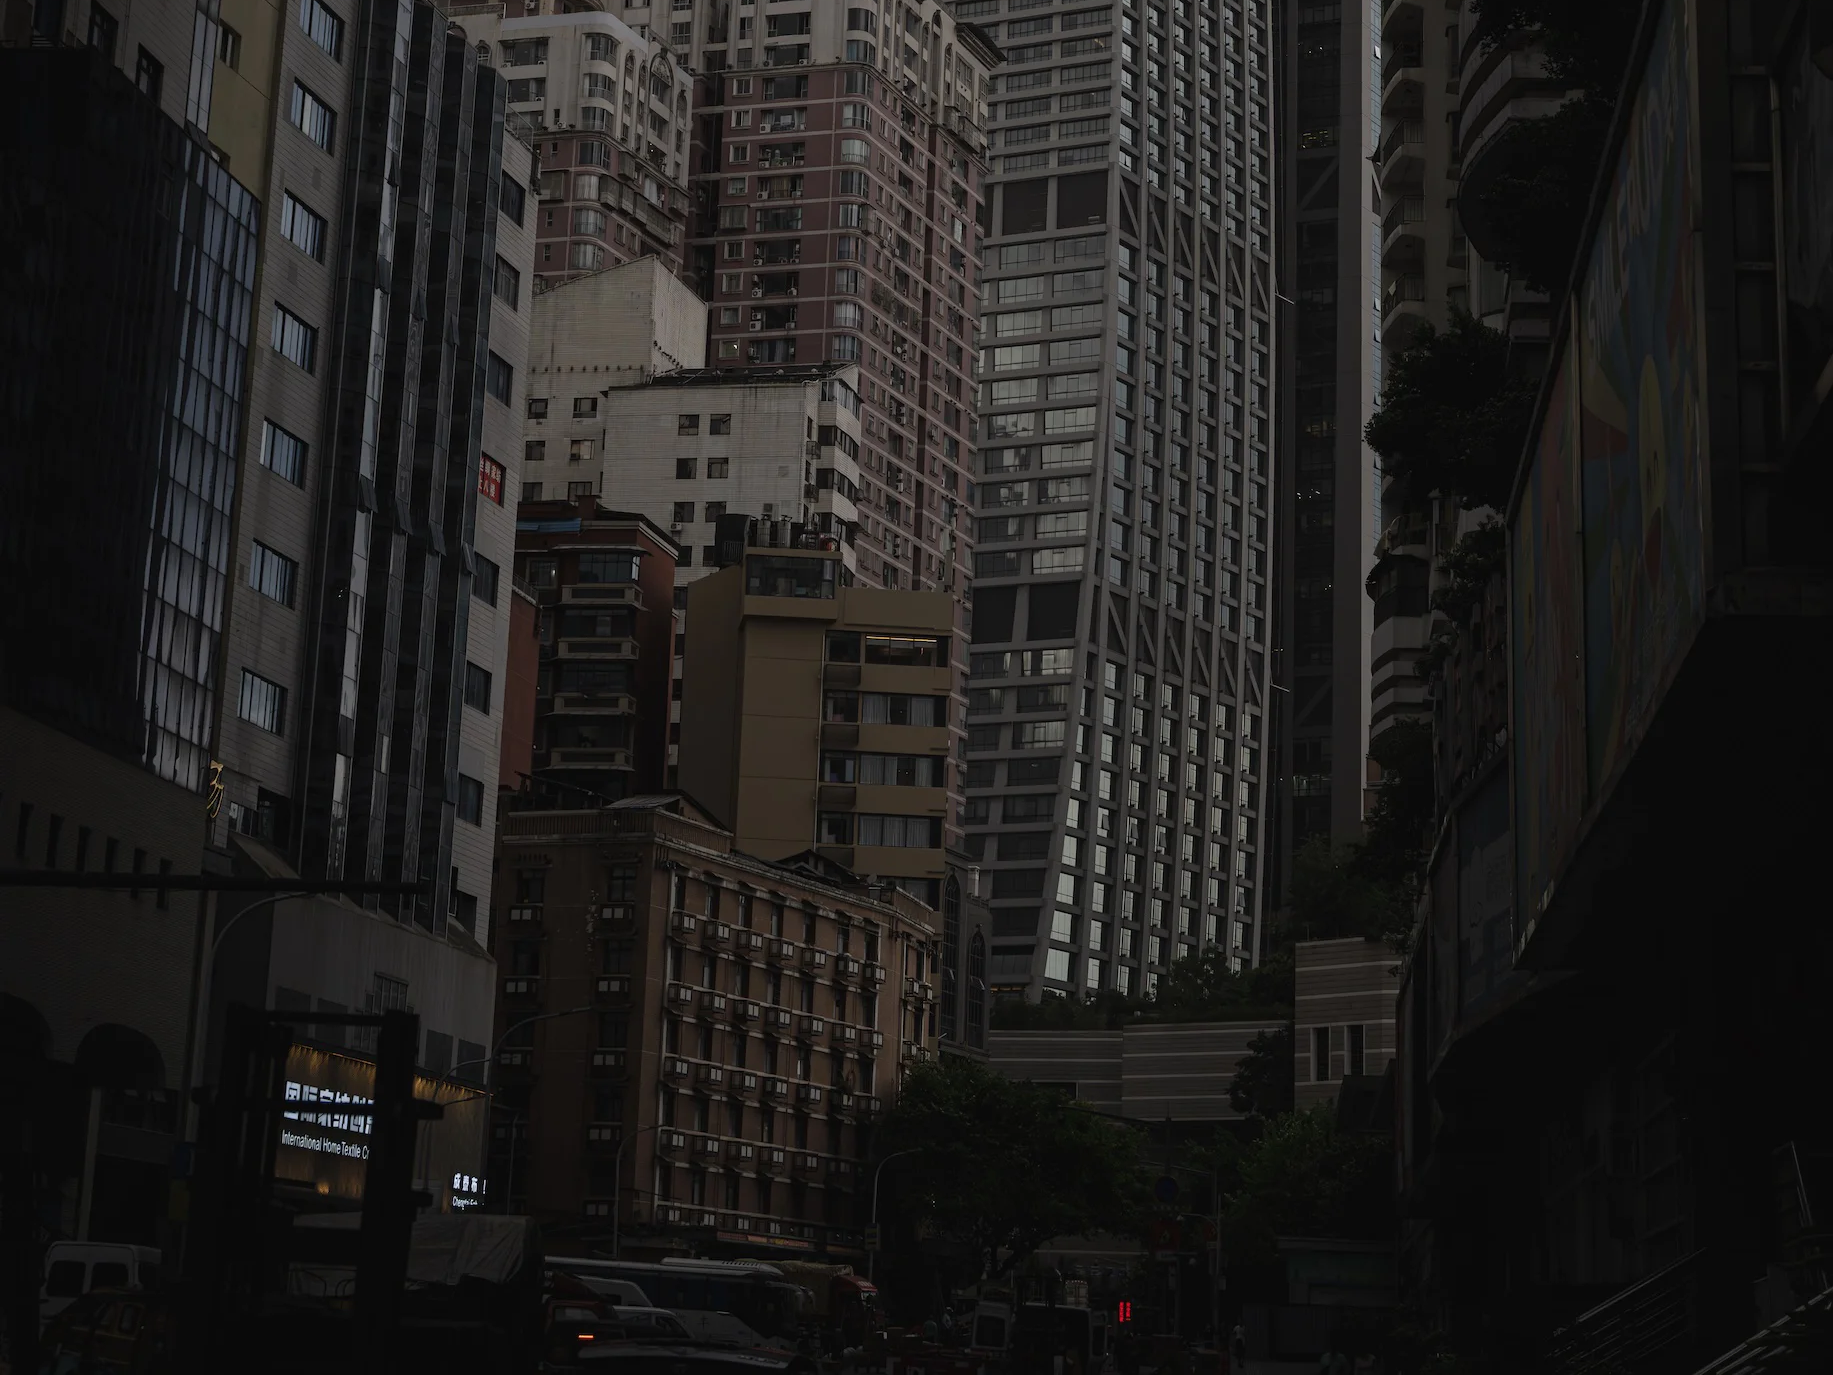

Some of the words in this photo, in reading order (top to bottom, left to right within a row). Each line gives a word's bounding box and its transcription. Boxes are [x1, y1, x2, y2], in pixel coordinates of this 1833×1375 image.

[281, 1129, 322, 1151] International
[322, 1137, 341, 1155] Home
[341, 1141, 361, 1158] Textile
